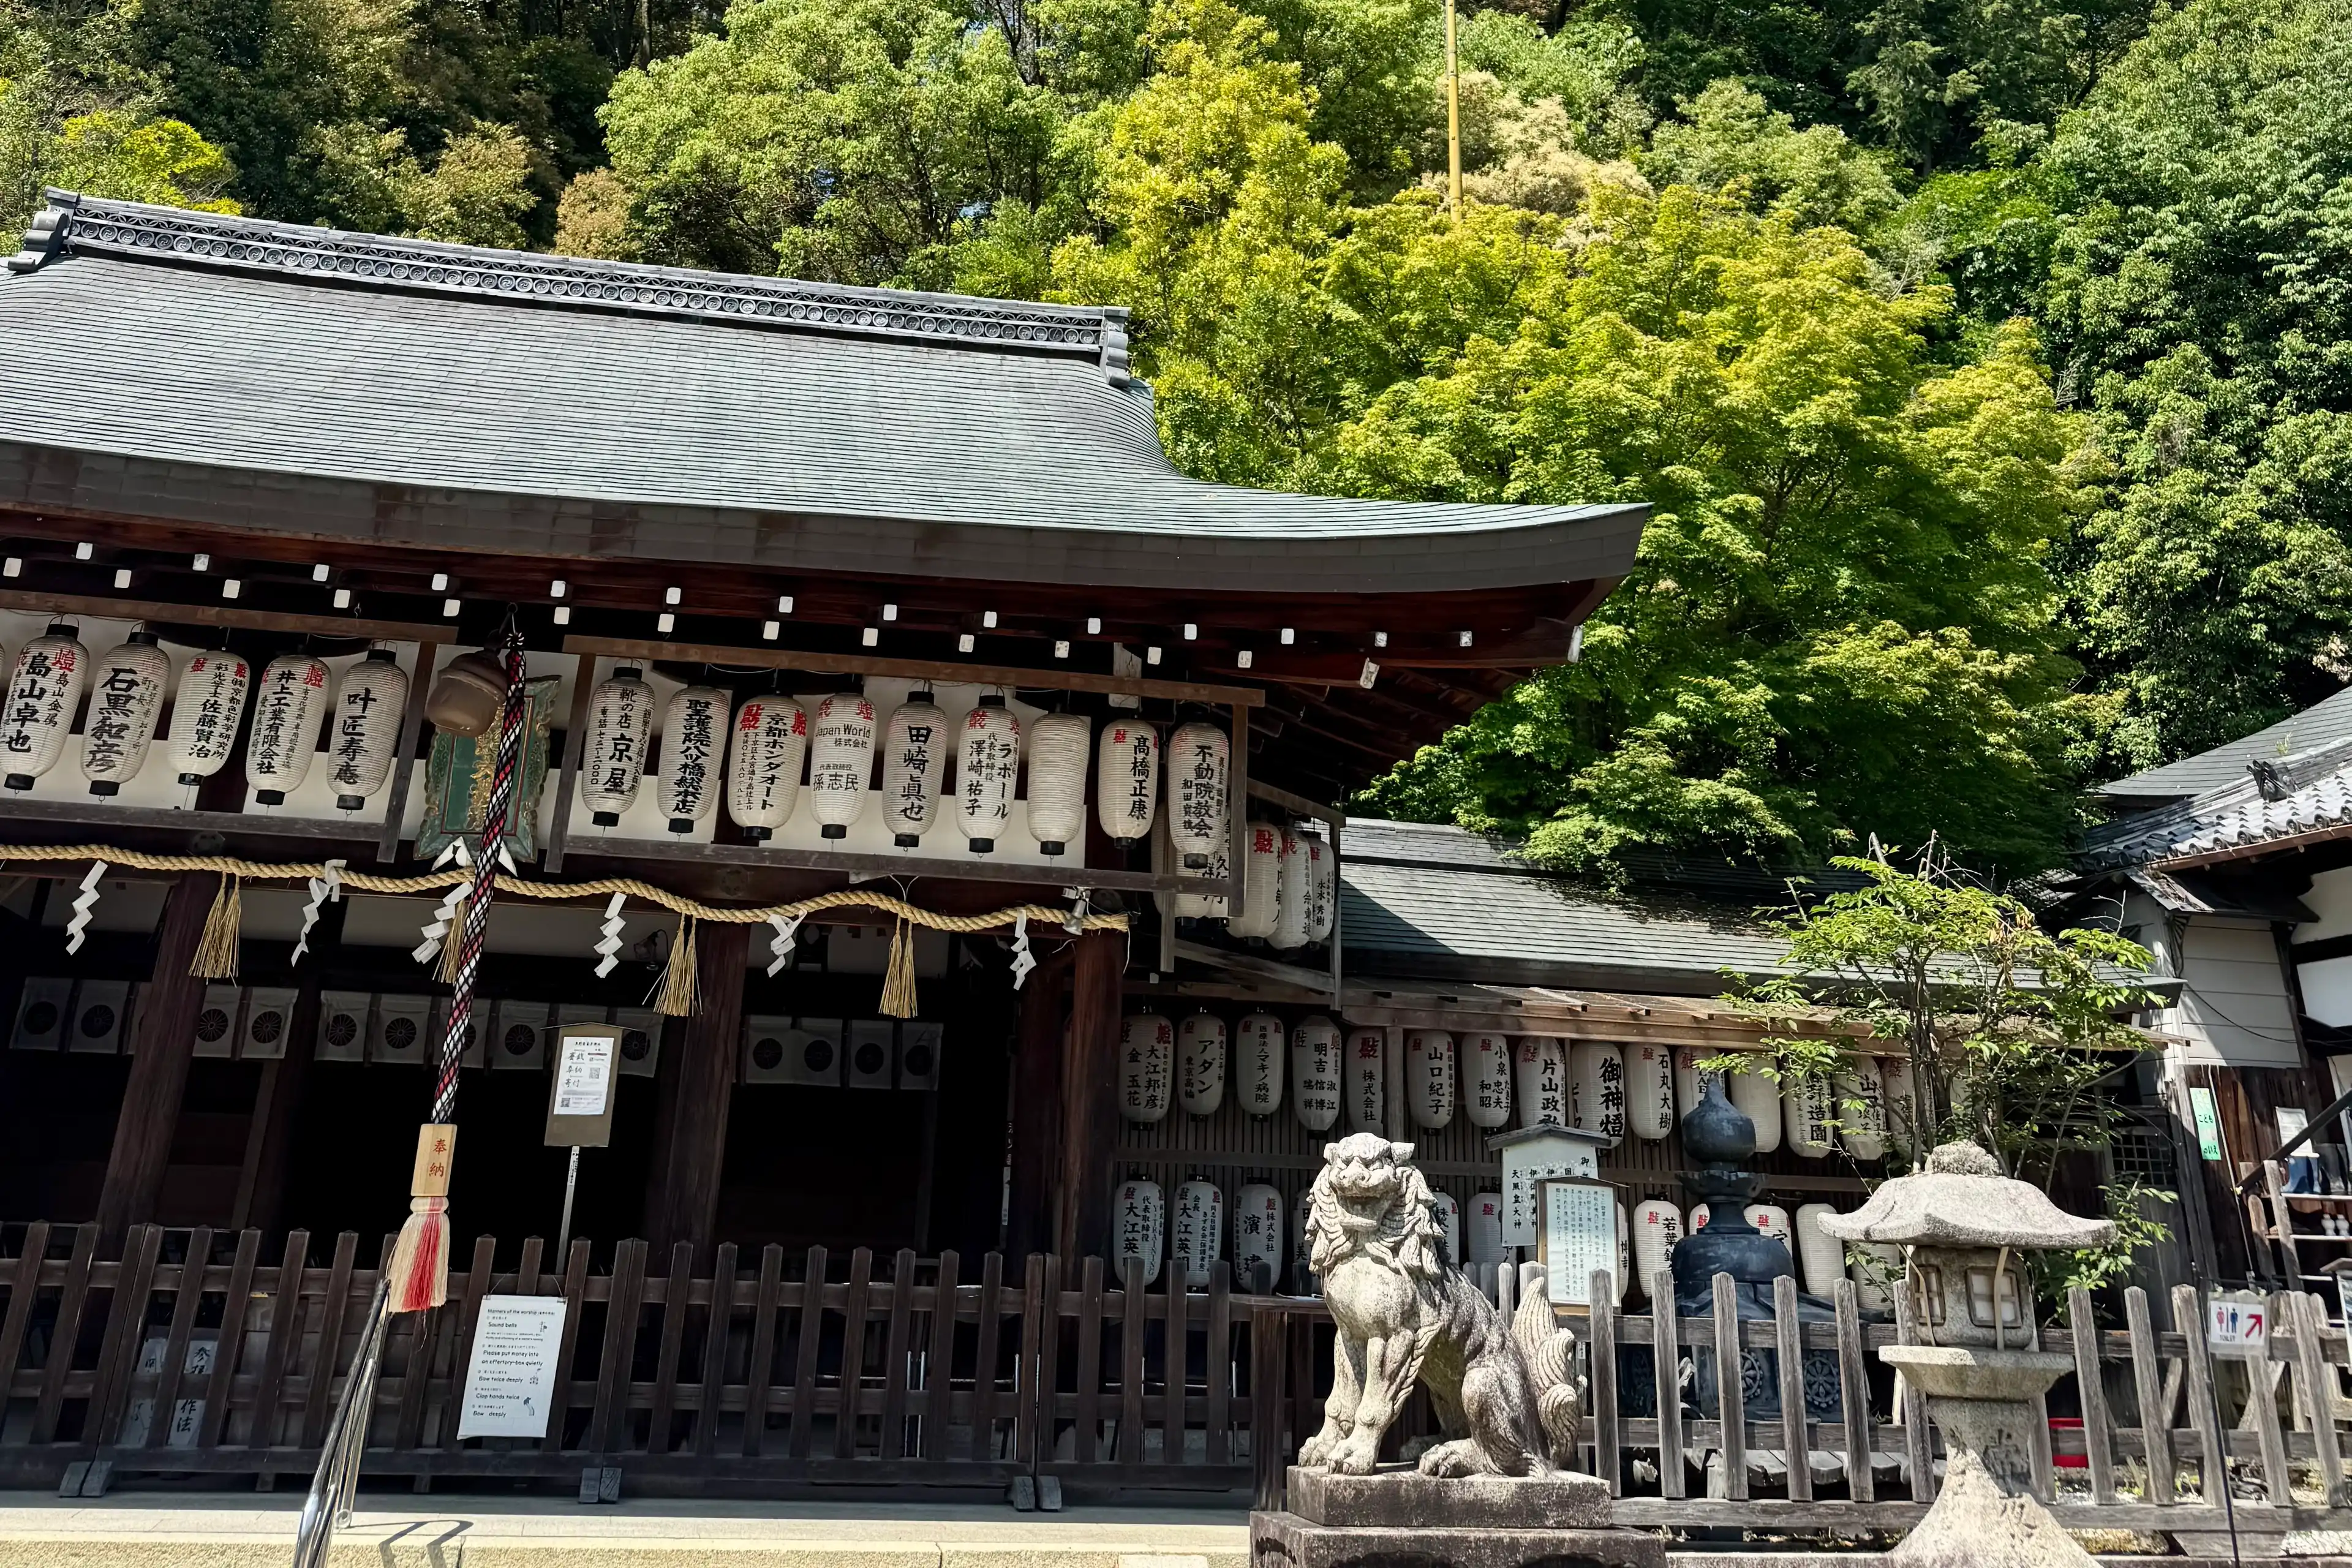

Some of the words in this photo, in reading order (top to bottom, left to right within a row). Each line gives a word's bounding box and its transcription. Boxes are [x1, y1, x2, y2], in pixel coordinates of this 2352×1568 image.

[255, 670, 296, 774] 井上工業有限会社
[816, 726, 840, 737] Japan
[843, 723, 870, 737] World
[834, 738, 867, 748] 株式会社
[758, 713, 789, 810] 京都ホンダオート
[813, 773, 859, 791] 孫志民
[986, 733, 997, 782] 代表取締役
[993, 743, 1012, 819] ラポール
[1194, 745, 1215, 838] 不動院教会
[1144, 1045, 1161, 1109] 大江邦彦
[1197, 1040, 1216, 1094] アダン
[1314, 1043, 1327, 1072] 明吉
[1428, 1047, 1445, 1114] 山口紀子
[1362, 1070, 1376, 1121] 株式会社
[1479, 1080, 1491, 1108] 和昭
[1599, 1056, 1623, 1137] 御神燈
[1658, 1054, 1671, 1130] 石丸大樹
[429, 1139, 447, 1177] 奉納
[1512, 1170, 1522, 1229] 天照皇大神
[1123, 1202, 1140, 1266] 大江英
[1265, 1212, 1275, 1252] 株式会社
